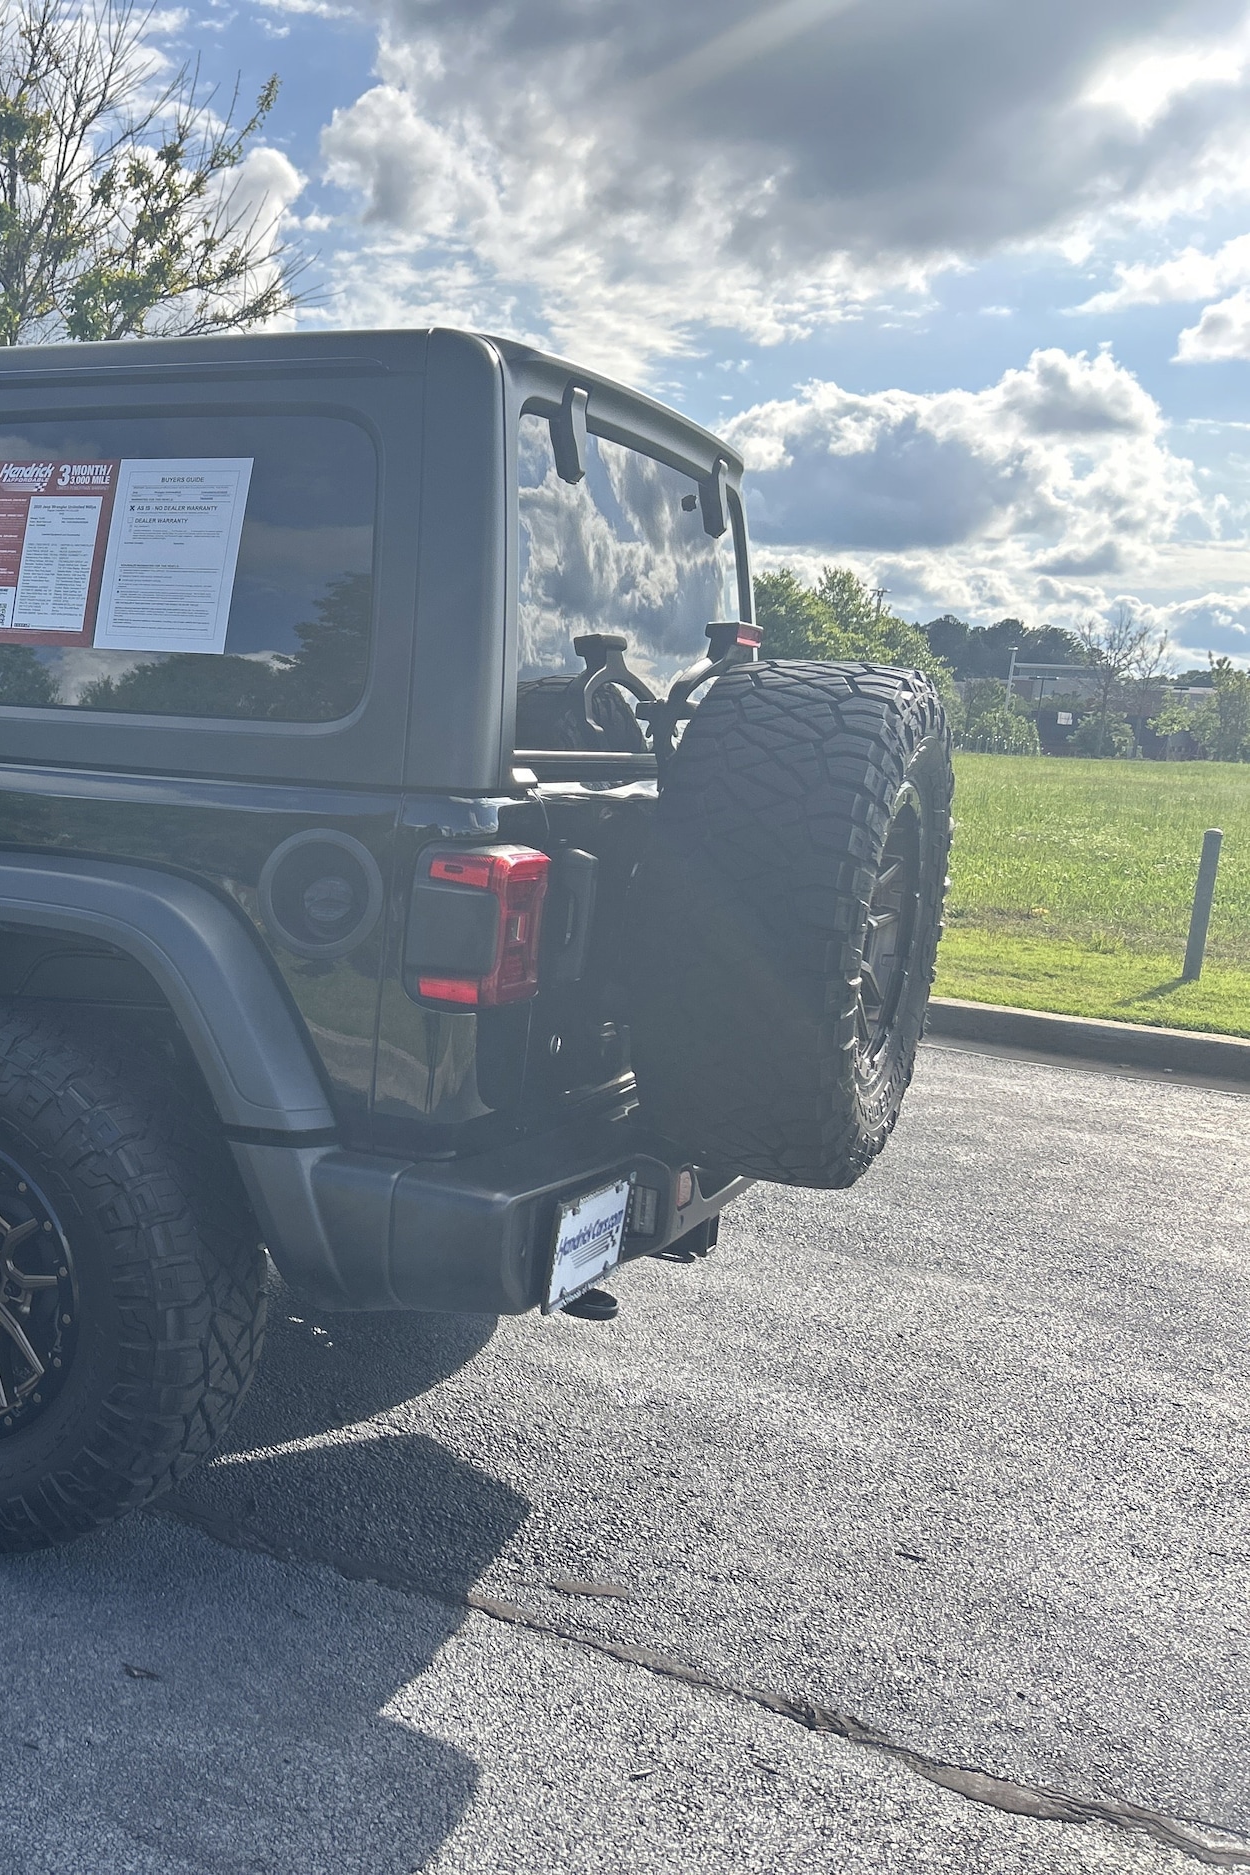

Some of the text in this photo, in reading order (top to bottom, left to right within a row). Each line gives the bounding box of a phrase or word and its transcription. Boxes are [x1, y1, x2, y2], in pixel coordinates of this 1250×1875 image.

[0, 463, 55, 483] Hendrick
[57, 464, 113, 487] 3 MONTH/
[70, 476, 111, 485] 3,000 MILE
